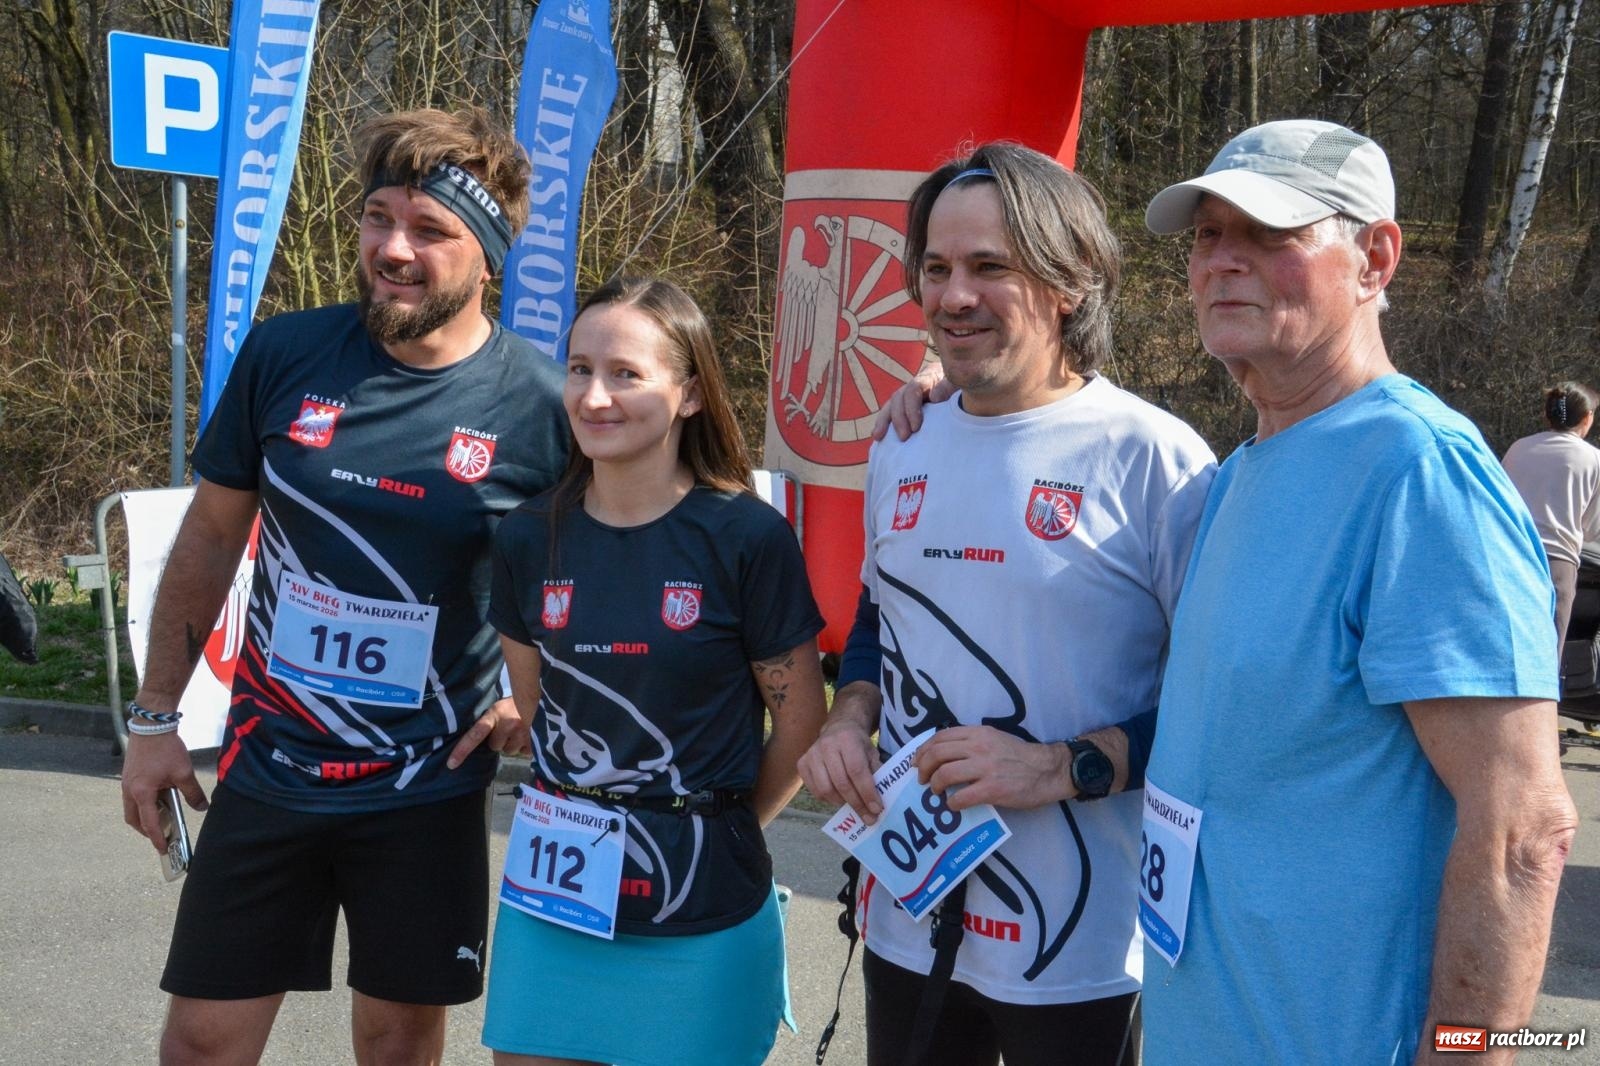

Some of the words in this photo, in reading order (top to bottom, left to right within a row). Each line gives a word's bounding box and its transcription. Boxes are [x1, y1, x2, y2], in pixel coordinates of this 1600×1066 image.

[144, 53, 219, 155] P
[304, 392, 346, 409] POLSKA
[454, 425, 498, 441] RACIBÓRZ
[899, 473, 928, 485] POLSKA
[1034, 478, 1085, 493] RACIBÓRZ
[543, 578, 574, 586] POLSKA
[664, 580, 703, 590] RACIBÓRZ
[288, 593, 296, 602] 15
[296, 598, 320, 612] marzec
[320, 606, 338, 617] 2026
[290, 581, 310, 597] XIV
[313, 590, 340, 609] BIEG
[310, 624, 388, 675] 116
[875, 751, 916, 795] TWARDZ
[534, 798, 552, 816] BIEG
[837, 814, 858, 835] XIV
[880, 787, 962, 873] 048
[849, 832, 859, 842] 15
[529, 835, 586, 894] 112
[1140, 830, 1165, 902] 28
